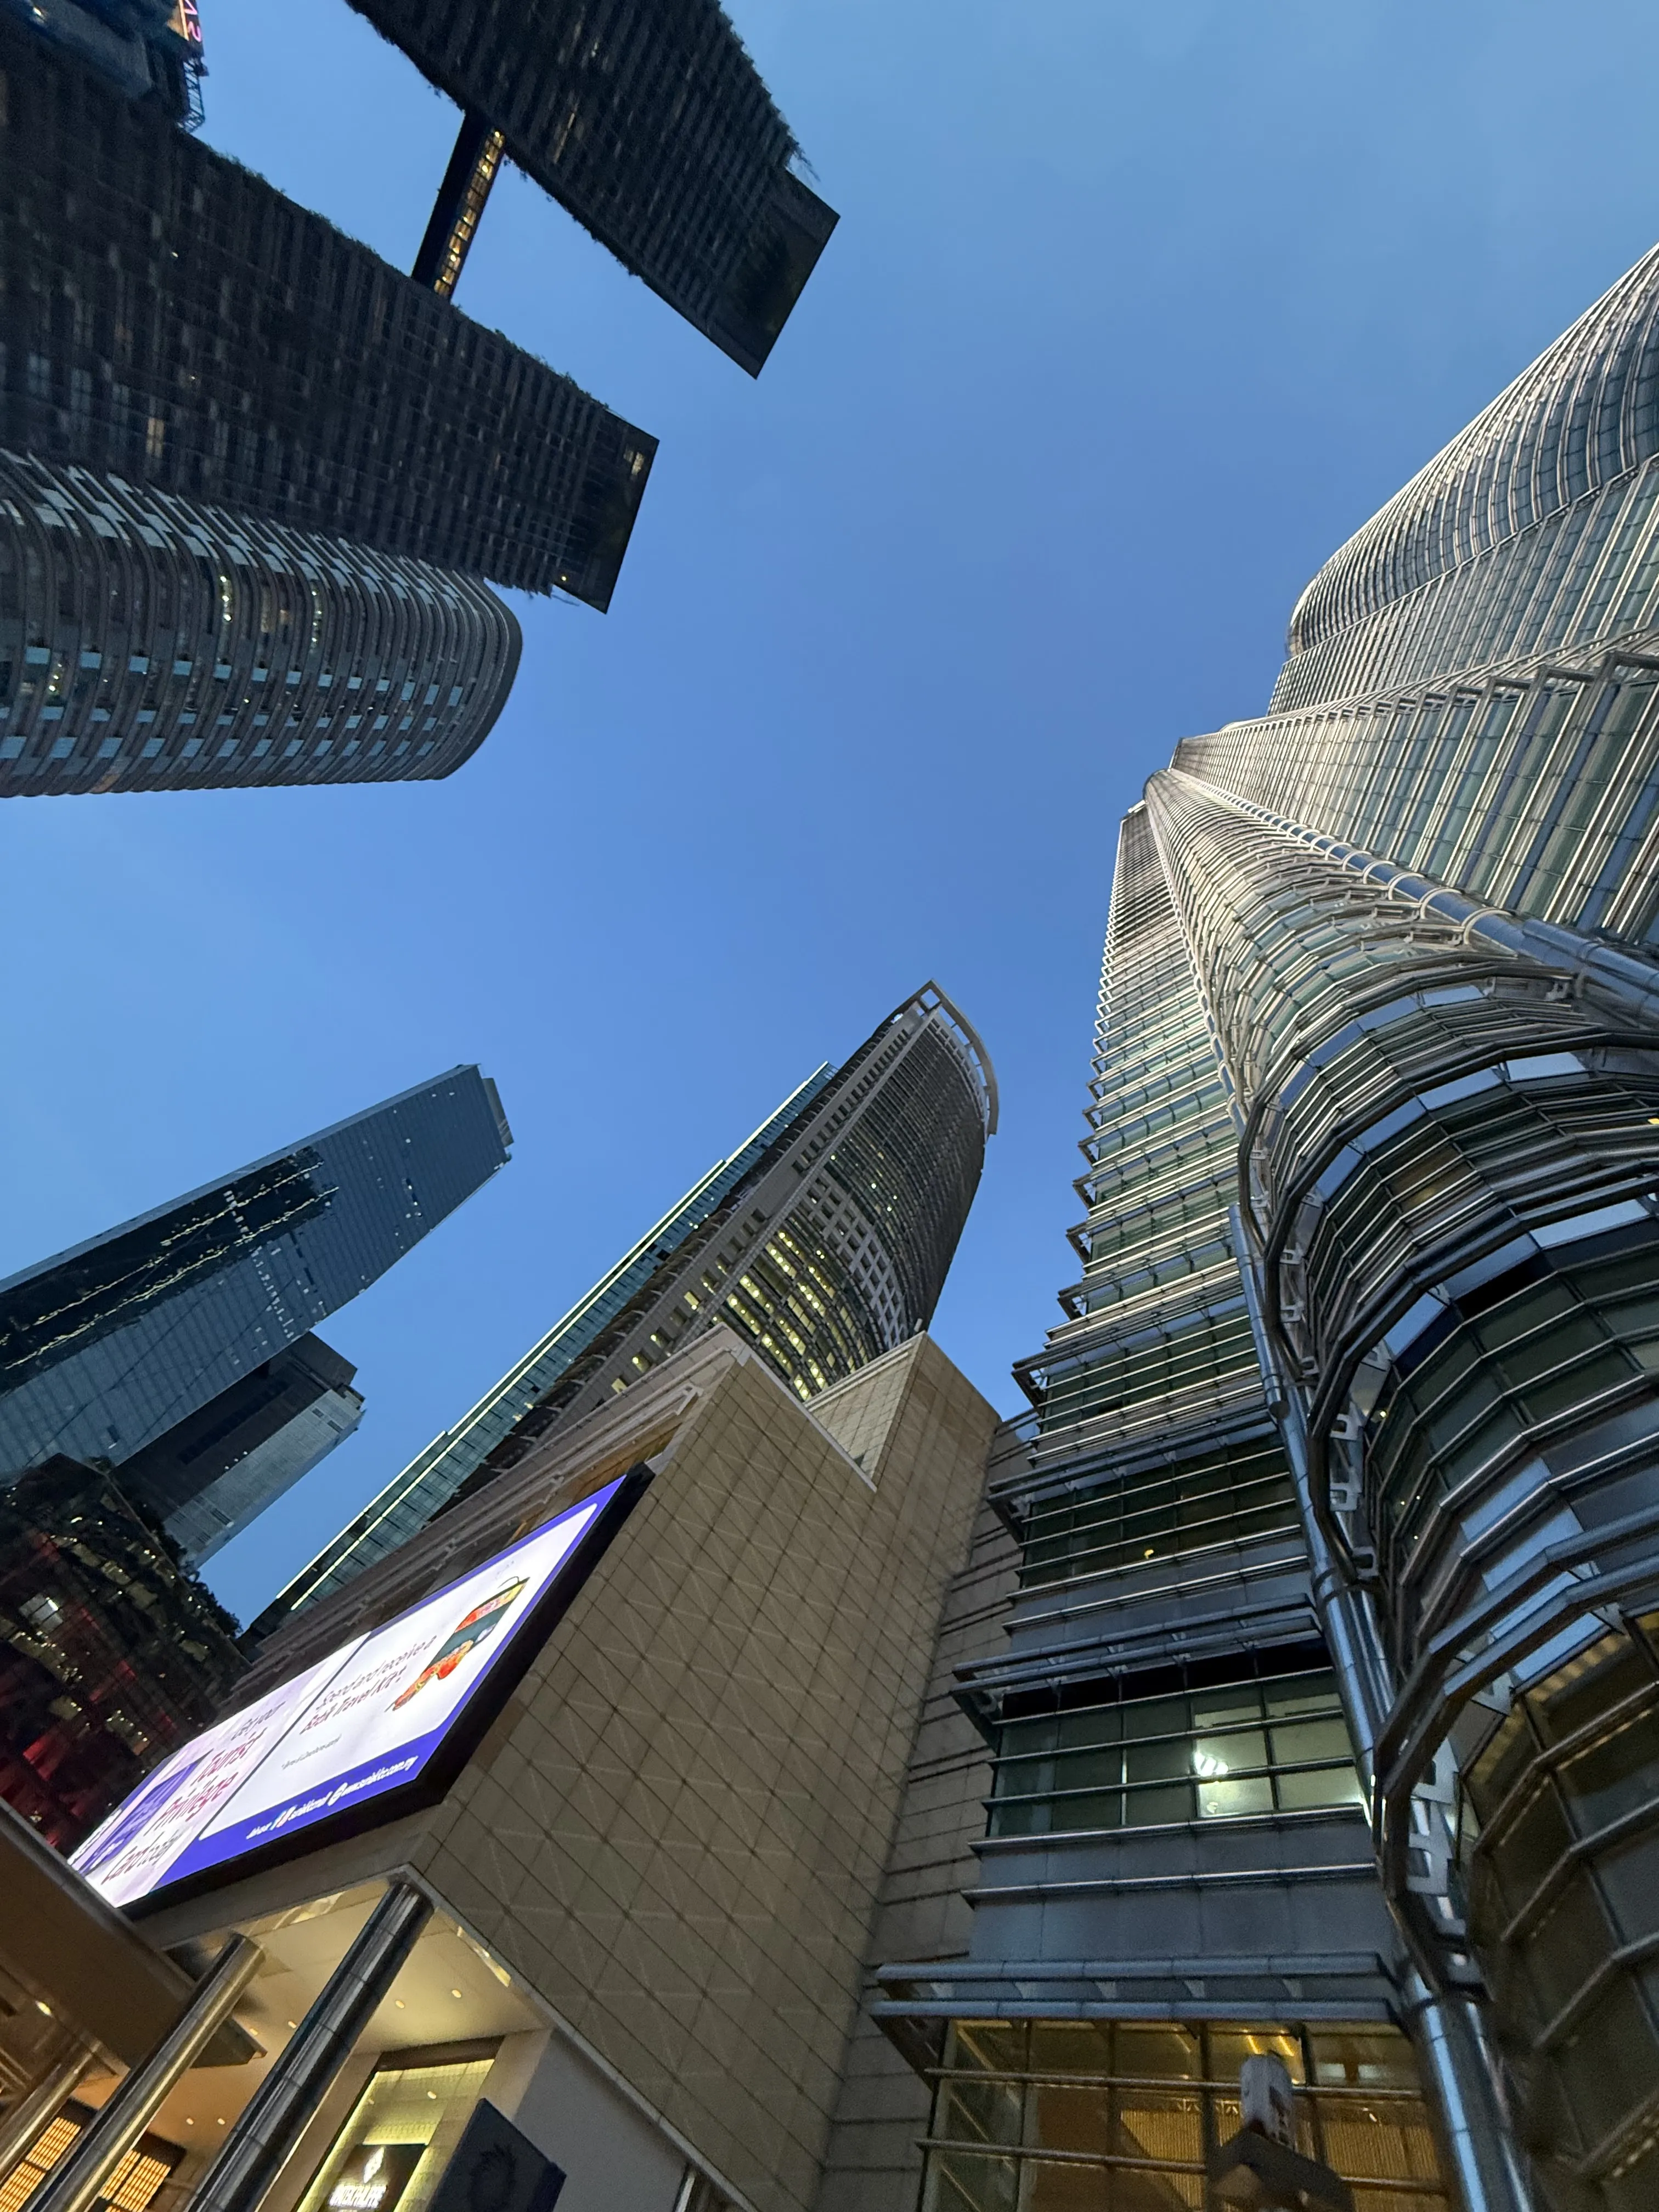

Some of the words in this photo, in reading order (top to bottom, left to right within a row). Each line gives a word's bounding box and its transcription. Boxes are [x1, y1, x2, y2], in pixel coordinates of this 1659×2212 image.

[315, 1674, 362, 1713] Spend
[352, 1660, 386, 1690] and
[377, 1643, 426, 1677] receive
[424, 1635, 437, 1650] a
[332, 1679, 380, 1717] Travel
[230, 1716, 259, 1741] Get
[244, 1701, 286, 1736] your
[190, 1727, 268, 1787] Tourist
[143, 1772, 239, 1836] Privilege
[101, 1831, 165, 1885] Card
[137, 1829, 184, 1867] today
